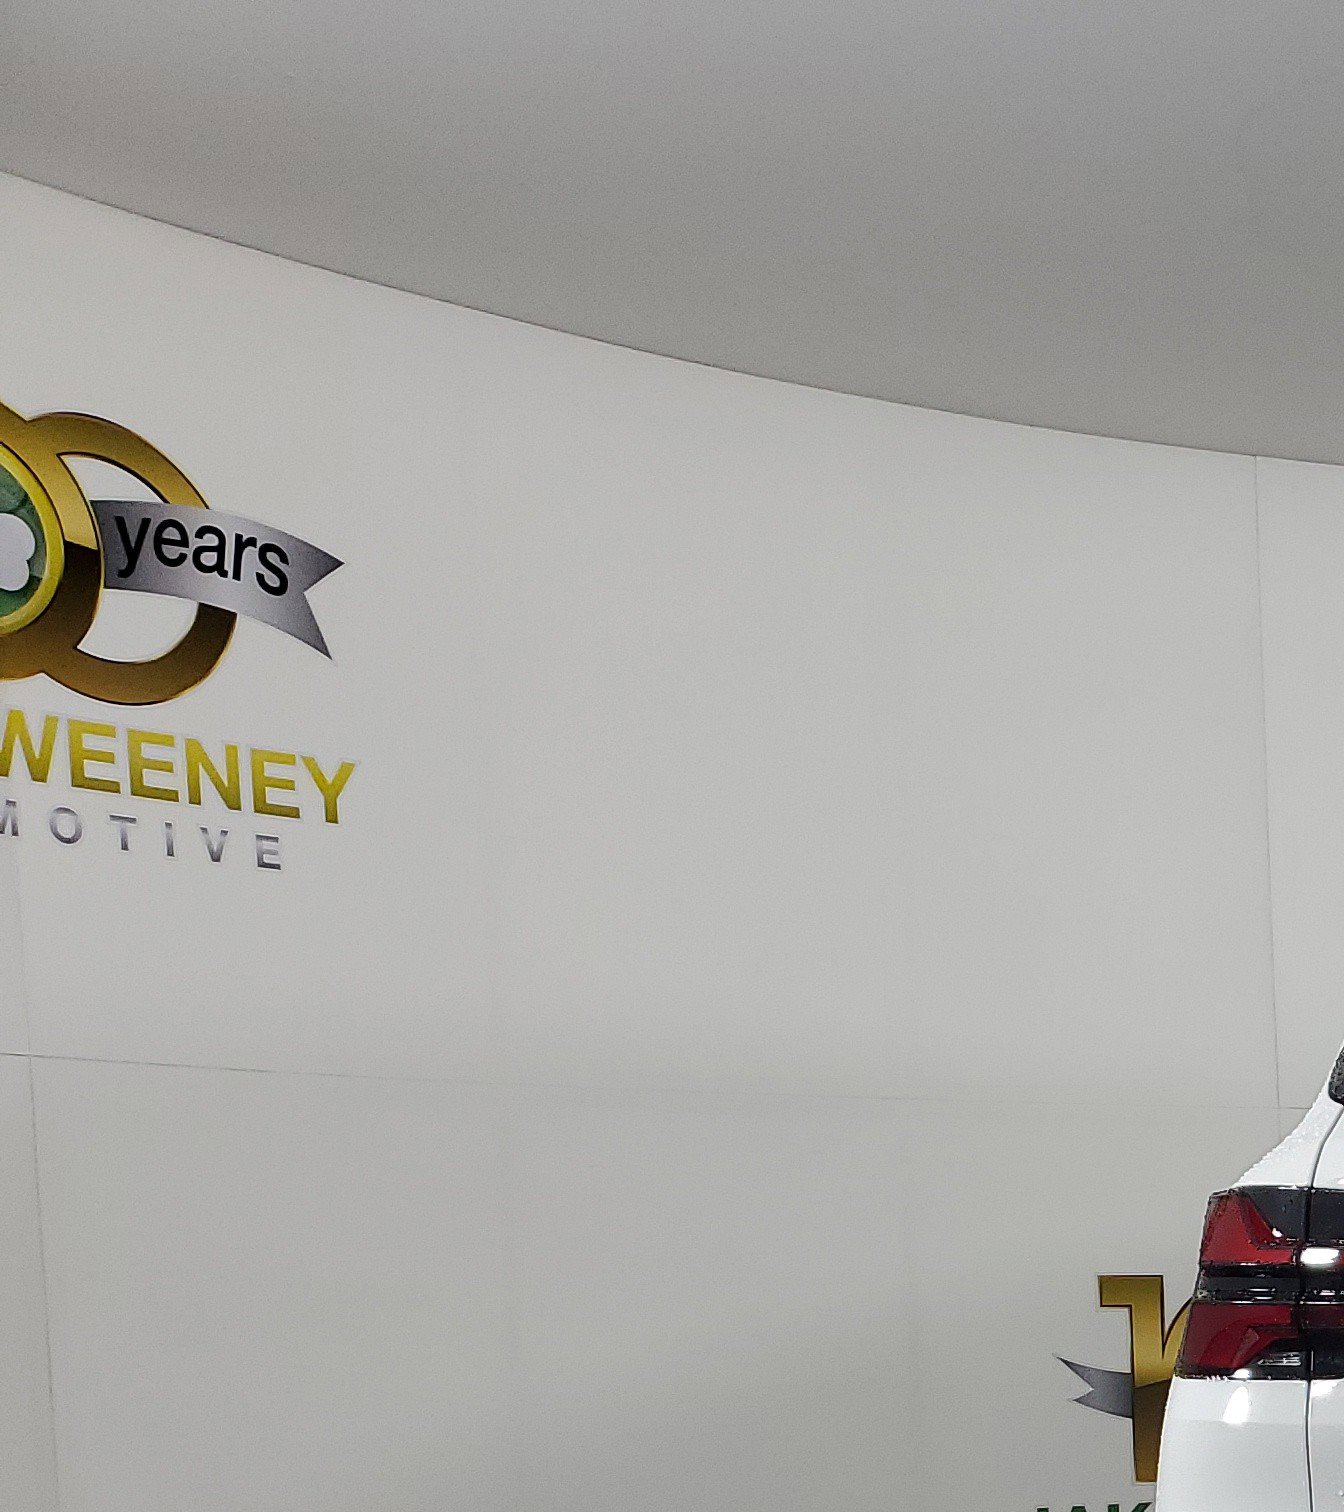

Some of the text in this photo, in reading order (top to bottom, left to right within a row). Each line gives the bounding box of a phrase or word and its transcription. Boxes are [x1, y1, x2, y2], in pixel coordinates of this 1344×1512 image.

[114, 515, 290, 596] years
[0, 709, 356, 825] WEENEY
[0, 799, 282, 871] MOTIVE
